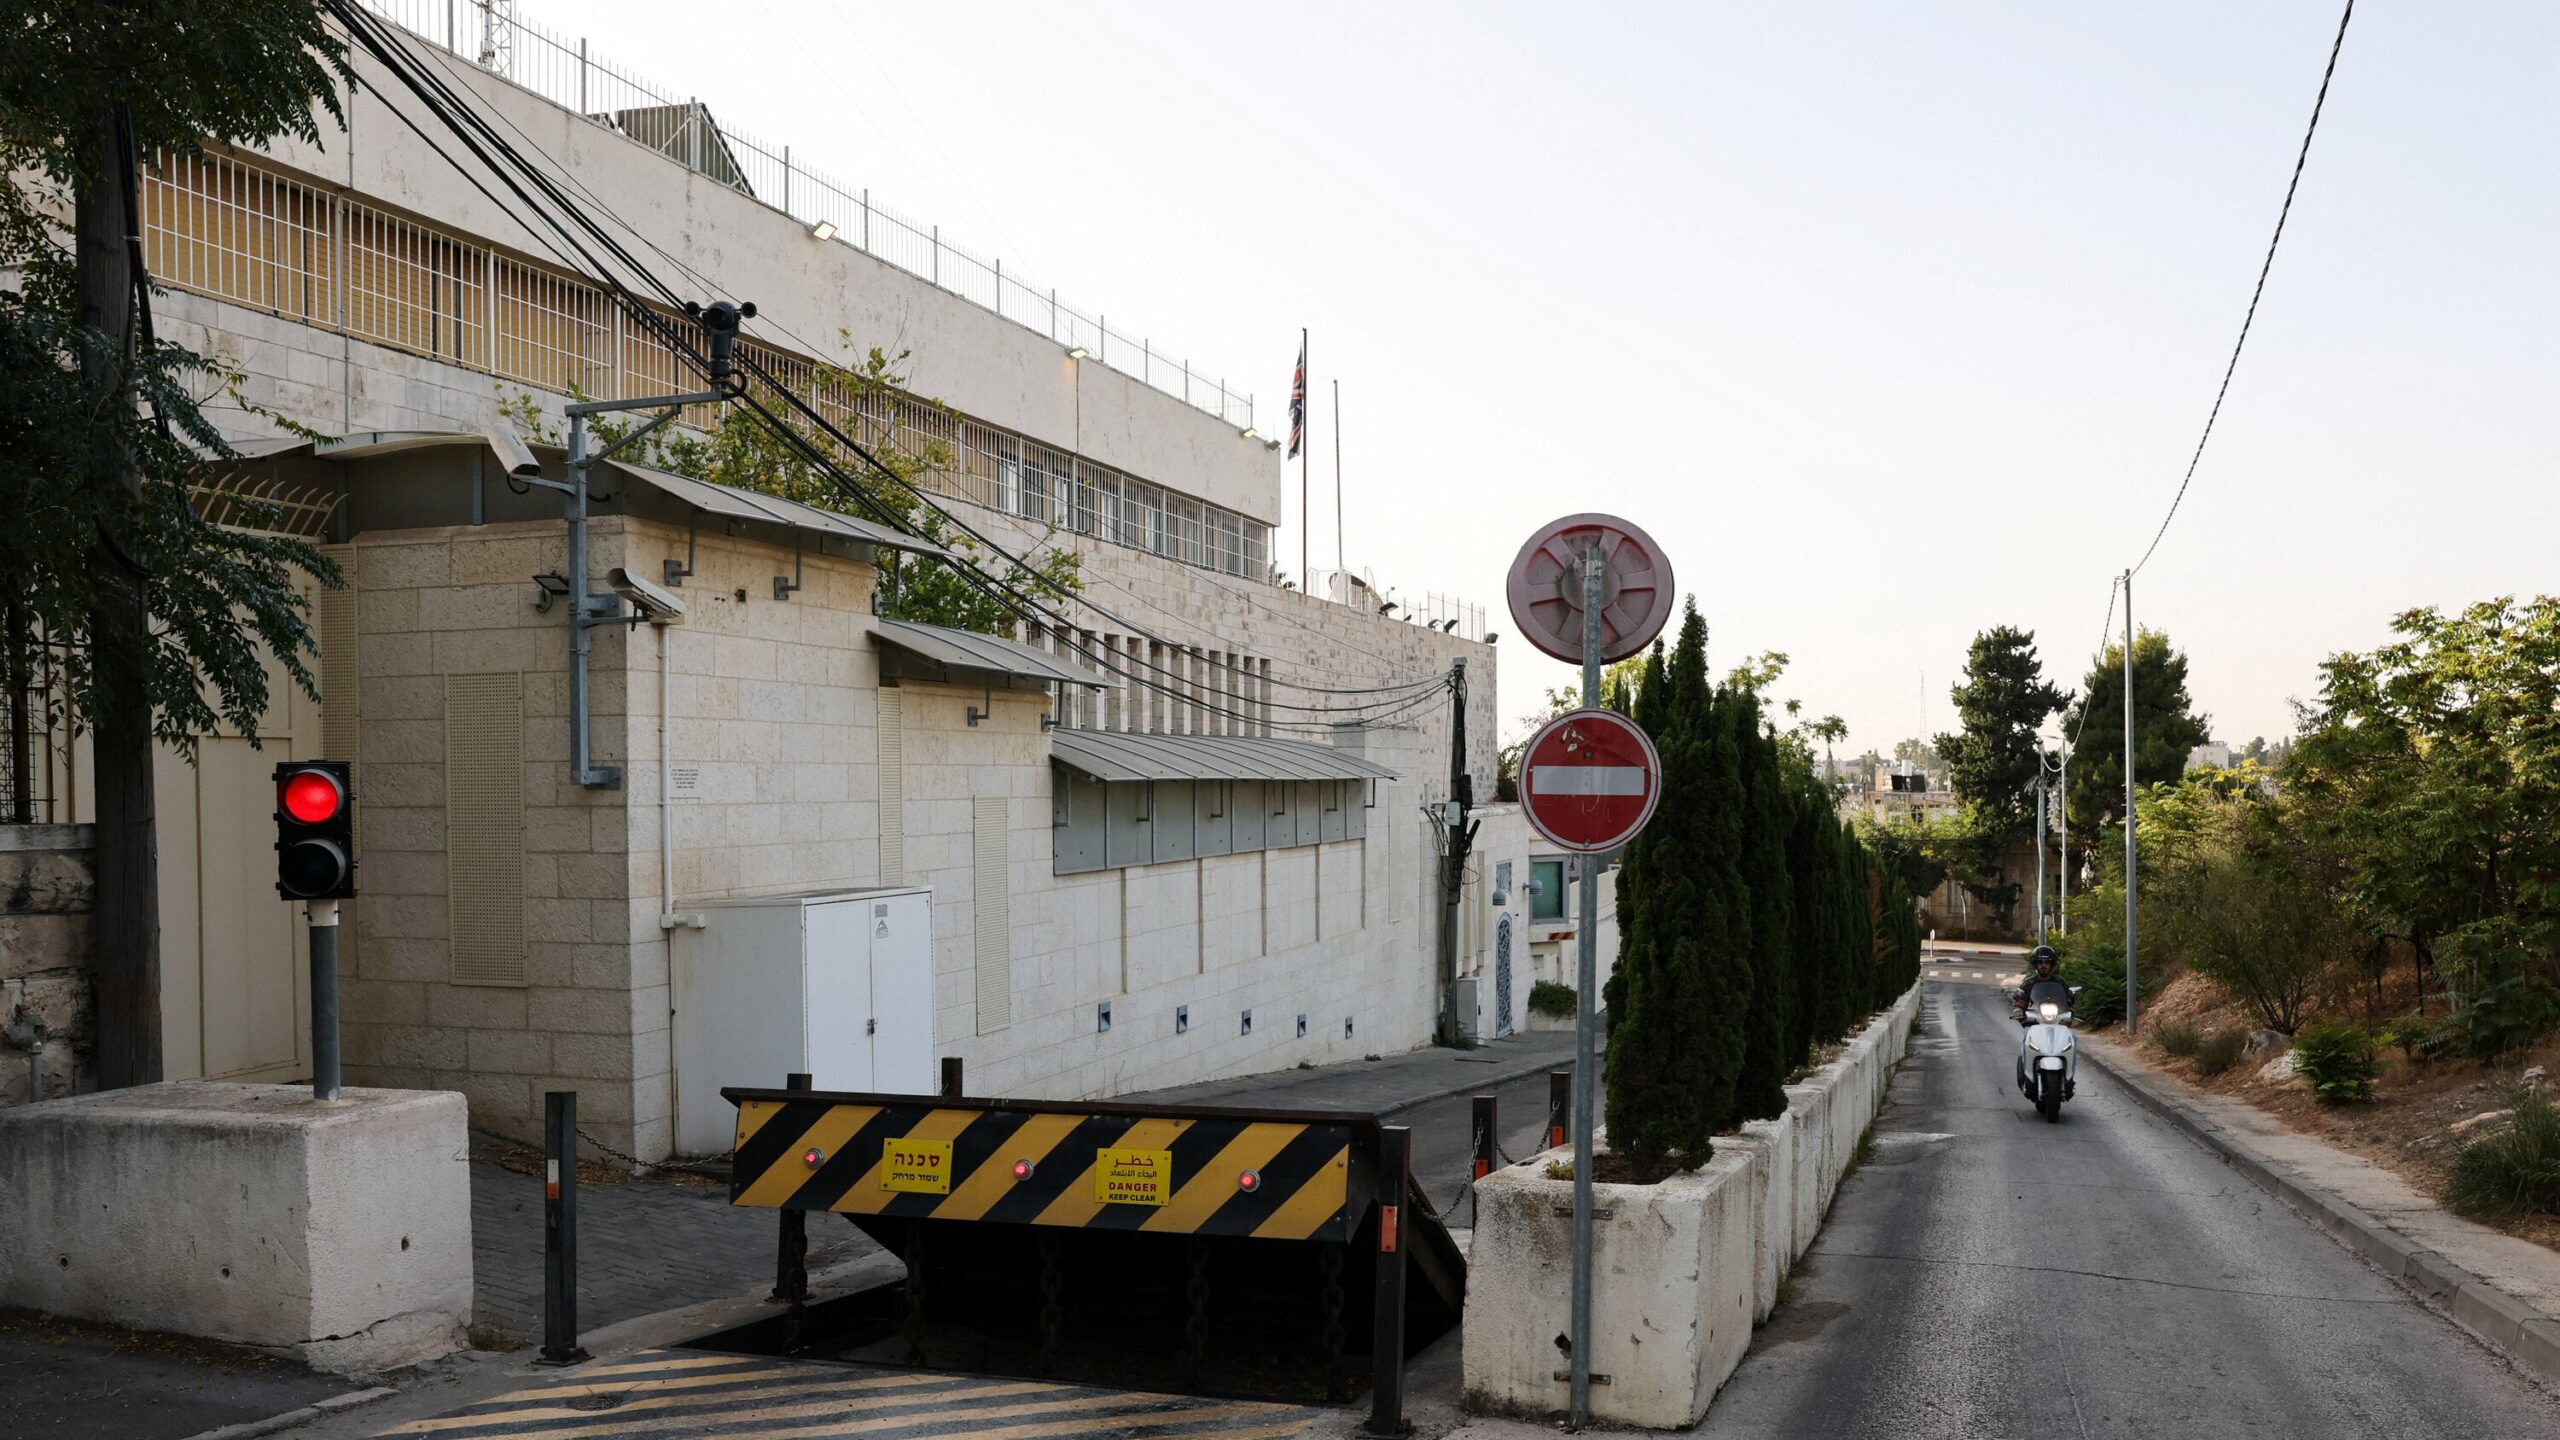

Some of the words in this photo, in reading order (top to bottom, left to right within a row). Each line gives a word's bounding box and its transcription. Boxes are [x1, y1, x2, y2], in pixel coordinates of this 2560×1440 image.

[895, 1152, 940, 1167] סכנה
[1114, 1154, 1153, 1168] خطر
[892, 1172, 915, 1181] מרחק
[1109, 1182, 1157, 1192] DANGER
[1130, 1194, 1155, 1202] CLEAR
